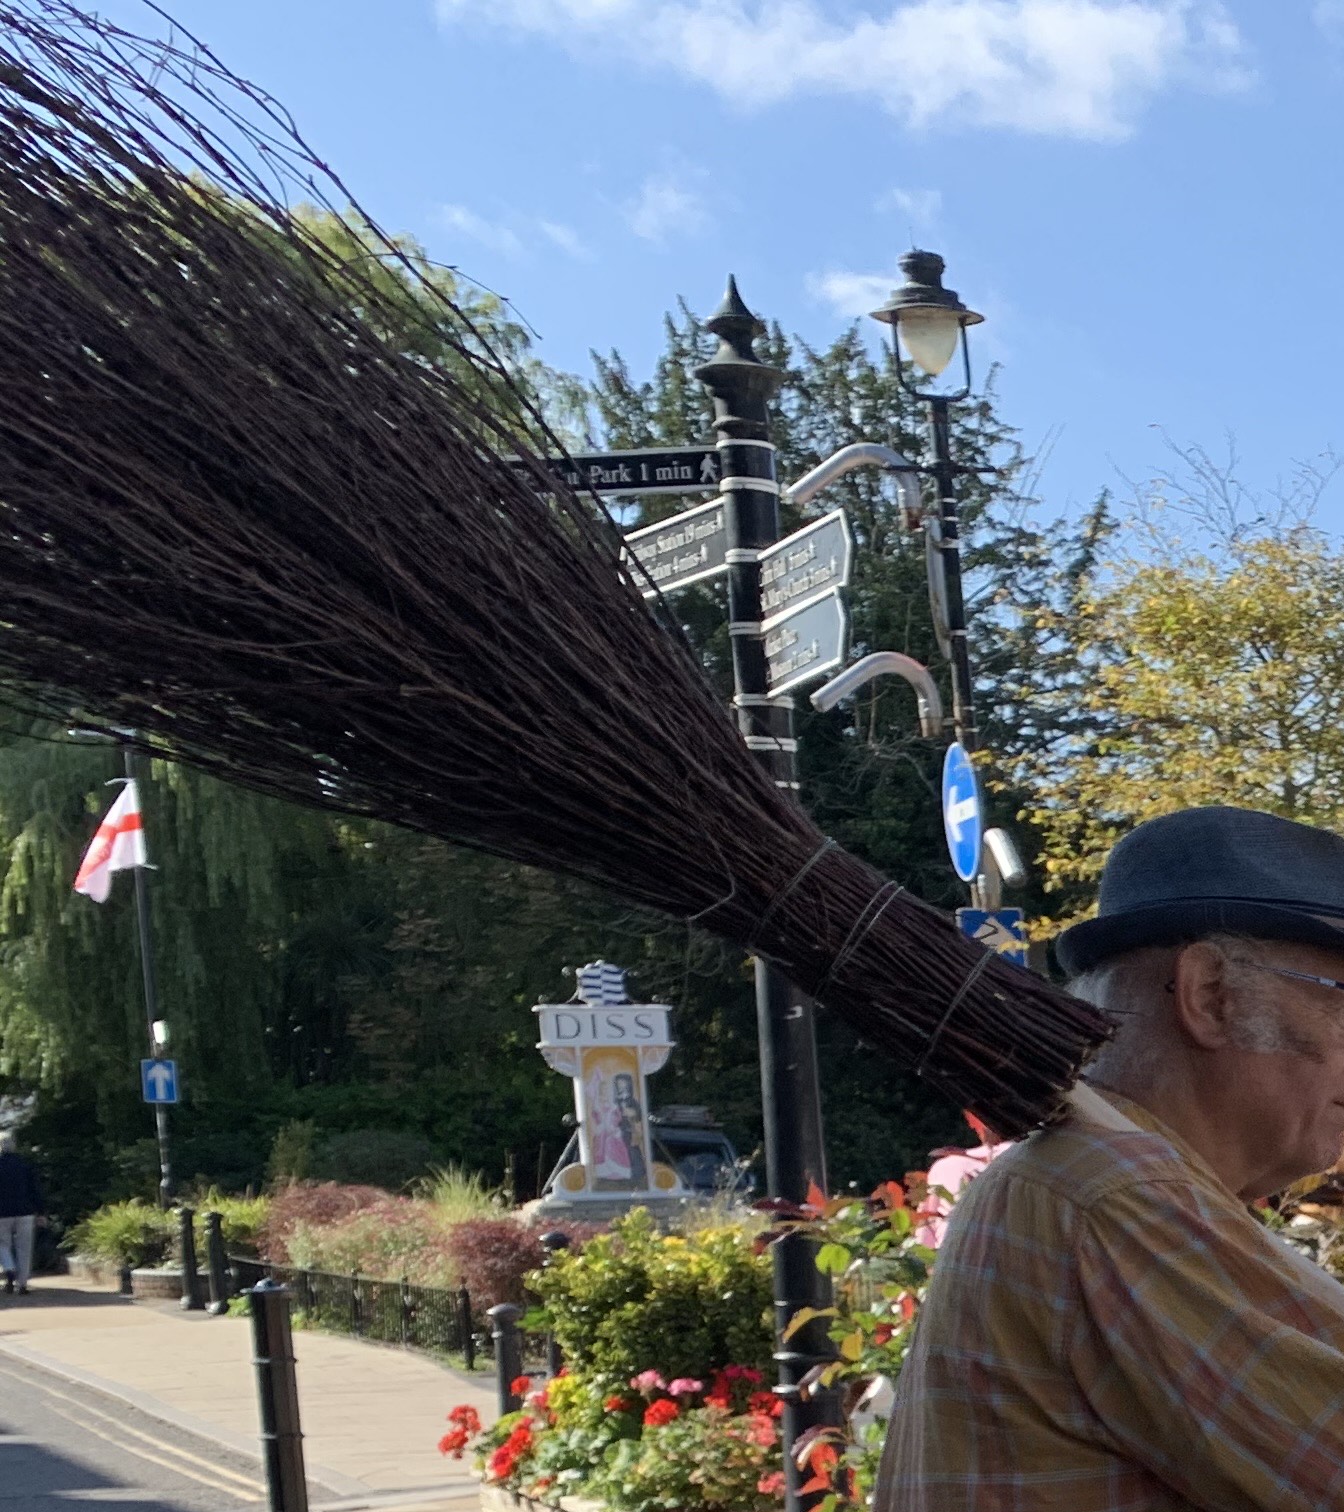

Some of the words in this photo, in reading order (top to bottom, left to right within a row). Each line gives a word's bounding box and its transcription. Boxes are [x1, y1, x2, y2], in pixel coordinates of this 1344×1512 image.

[589, 463, 632, 483] Park
[640, 462, 649, 481] 1
[655, 460, 693, 481] min
[555, 1013, 654, 1039] DISS
